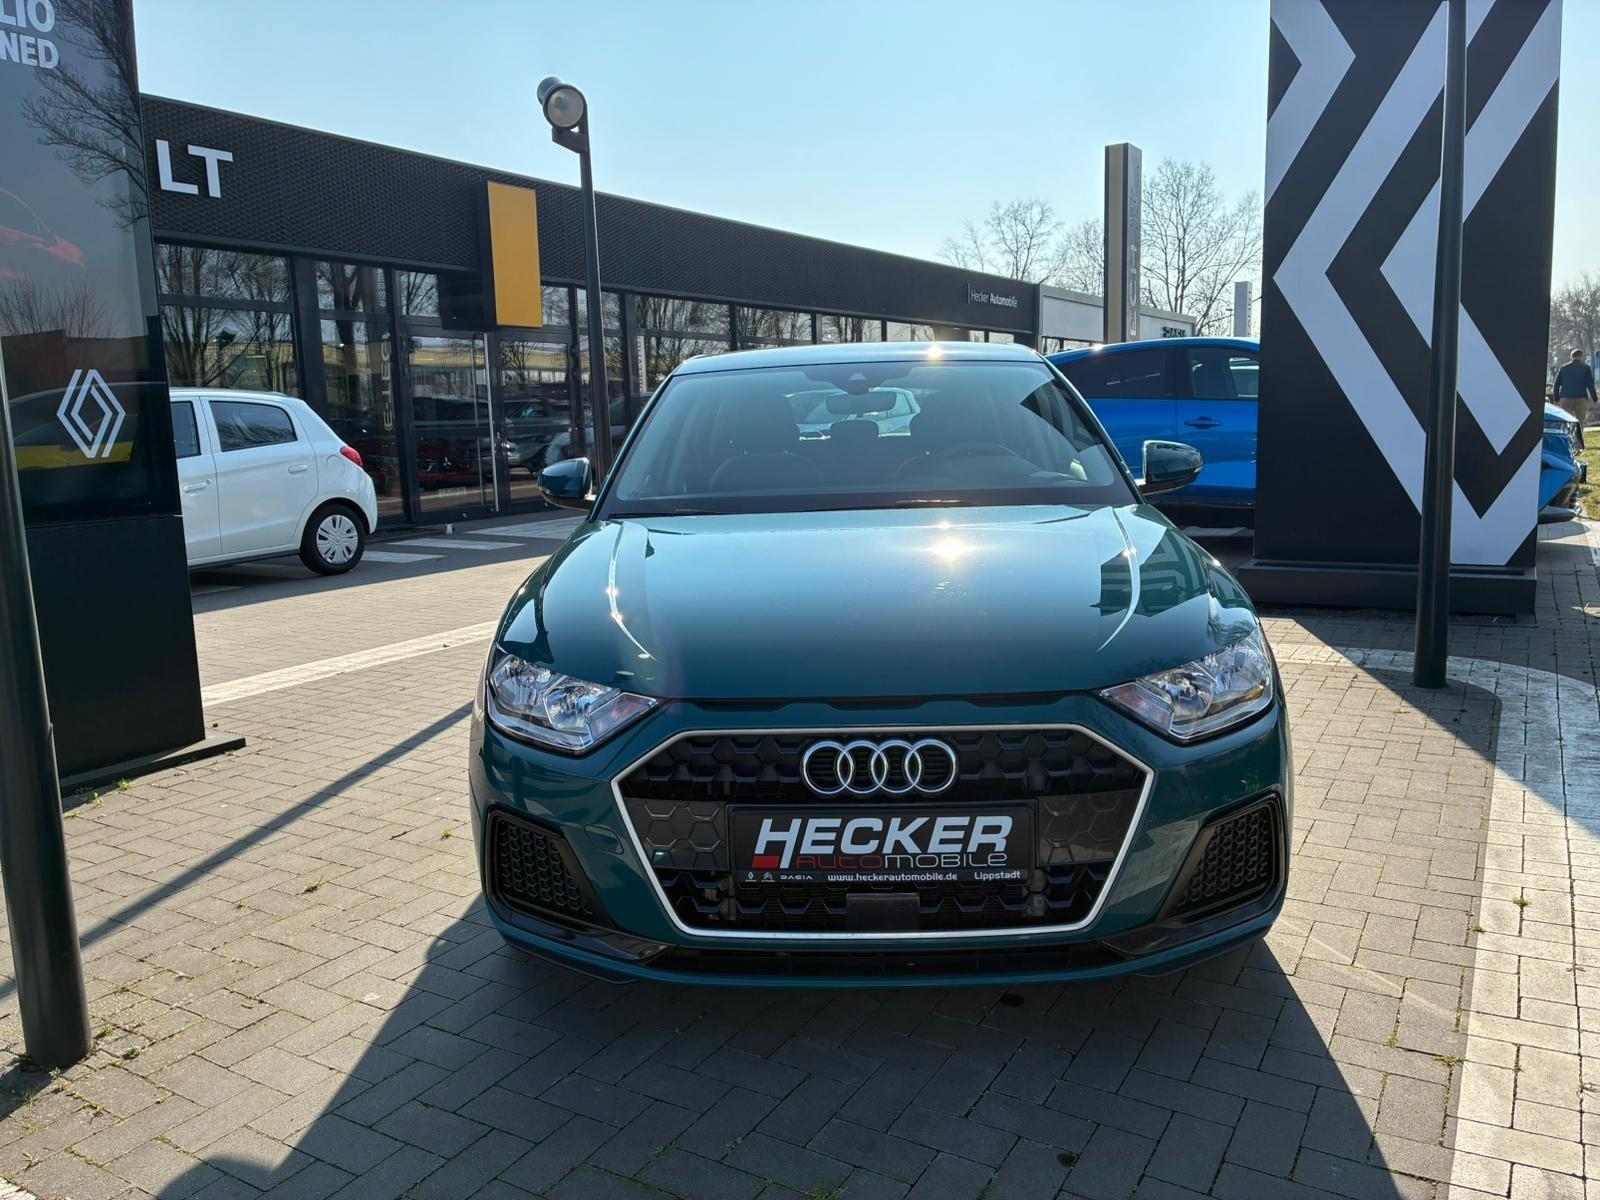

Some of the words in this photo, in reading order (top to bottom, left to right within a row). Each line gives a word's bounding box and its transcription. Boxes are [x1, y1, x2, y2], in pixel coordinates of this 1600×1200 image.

[156, 139, 233, 198] LT
[971, 289, 989, 303] Hecker
[990, 292, 1018, 308] Automobile
[754, 816, 1013, 869] HECKER
[827, 872, 958, 881] www.heckerautomobile.de
[974, 870, 1021, 881] Lippstadt
